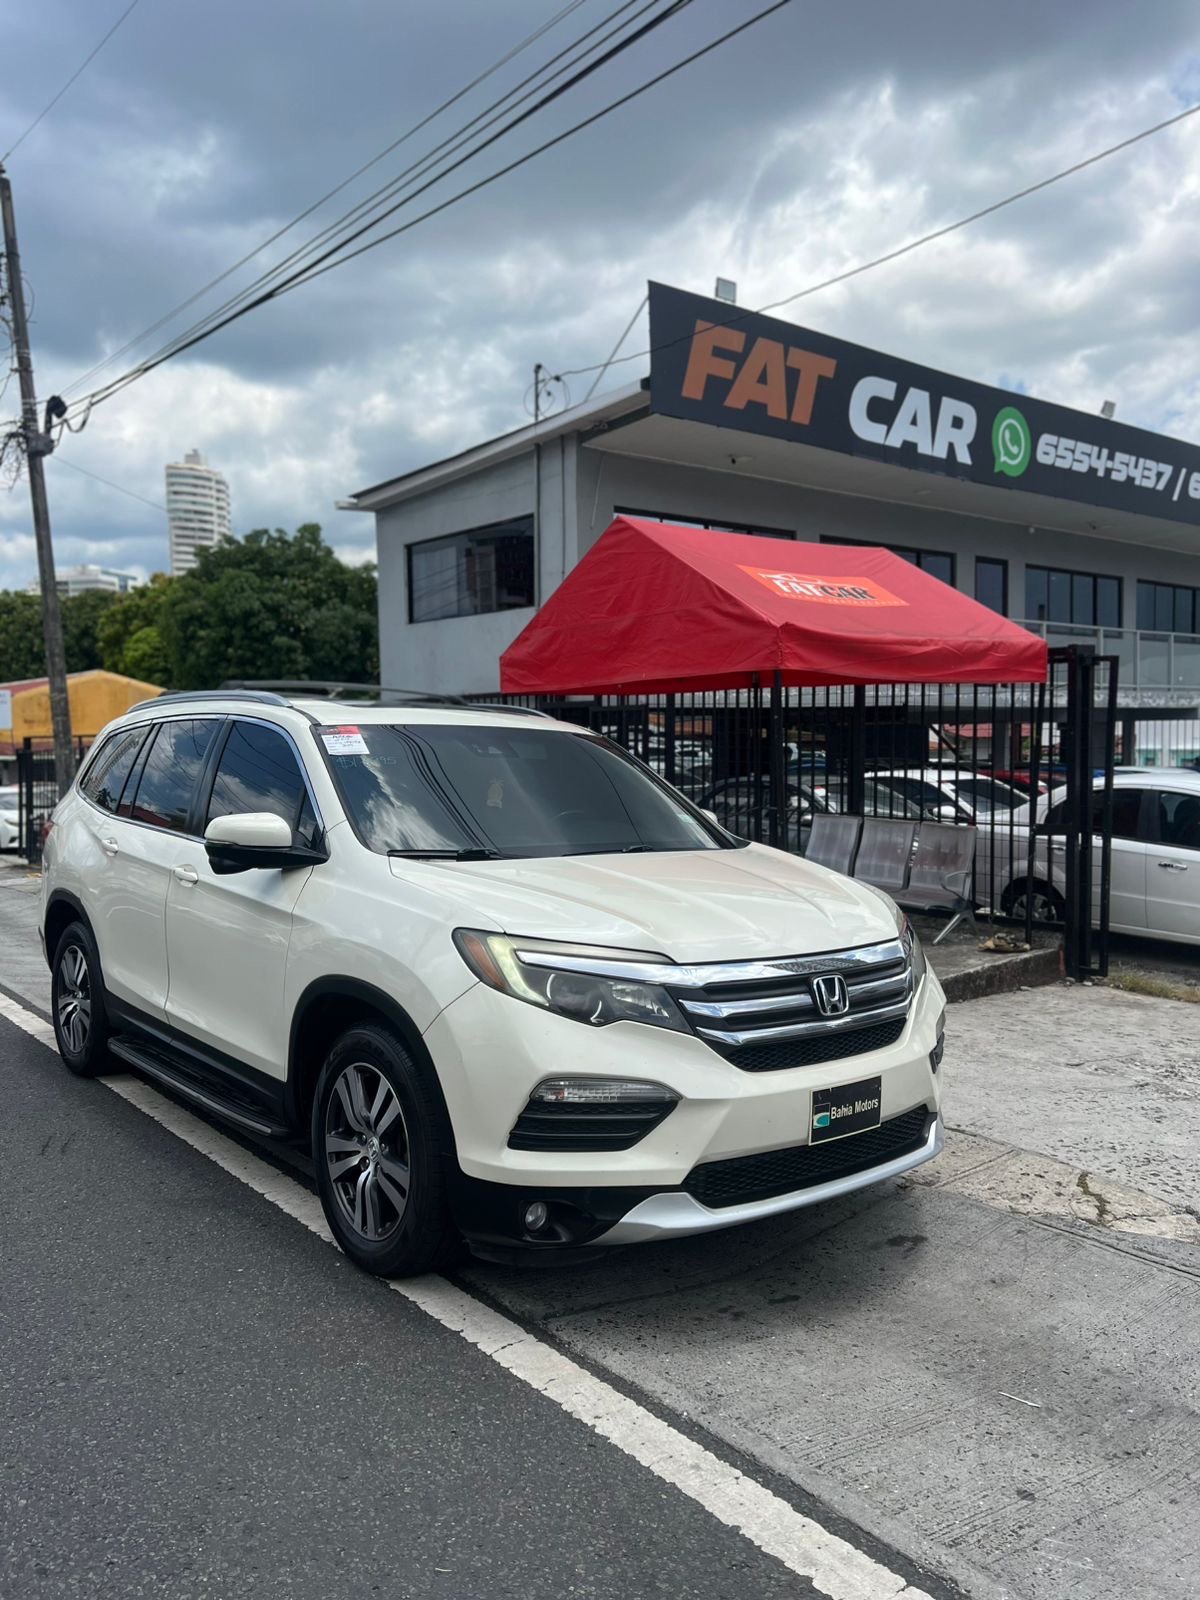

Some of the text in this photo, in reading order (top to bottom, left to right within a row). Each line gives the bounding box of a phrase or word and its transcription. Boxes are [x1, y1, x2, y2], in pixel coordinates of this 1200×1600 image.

[681, 319, 837, 425] FAT
[848, 375, 978, 465] CAR
[1035, 432, 1174, 491] 6554-5437
[854, 1098, 879, 1114] Motors
